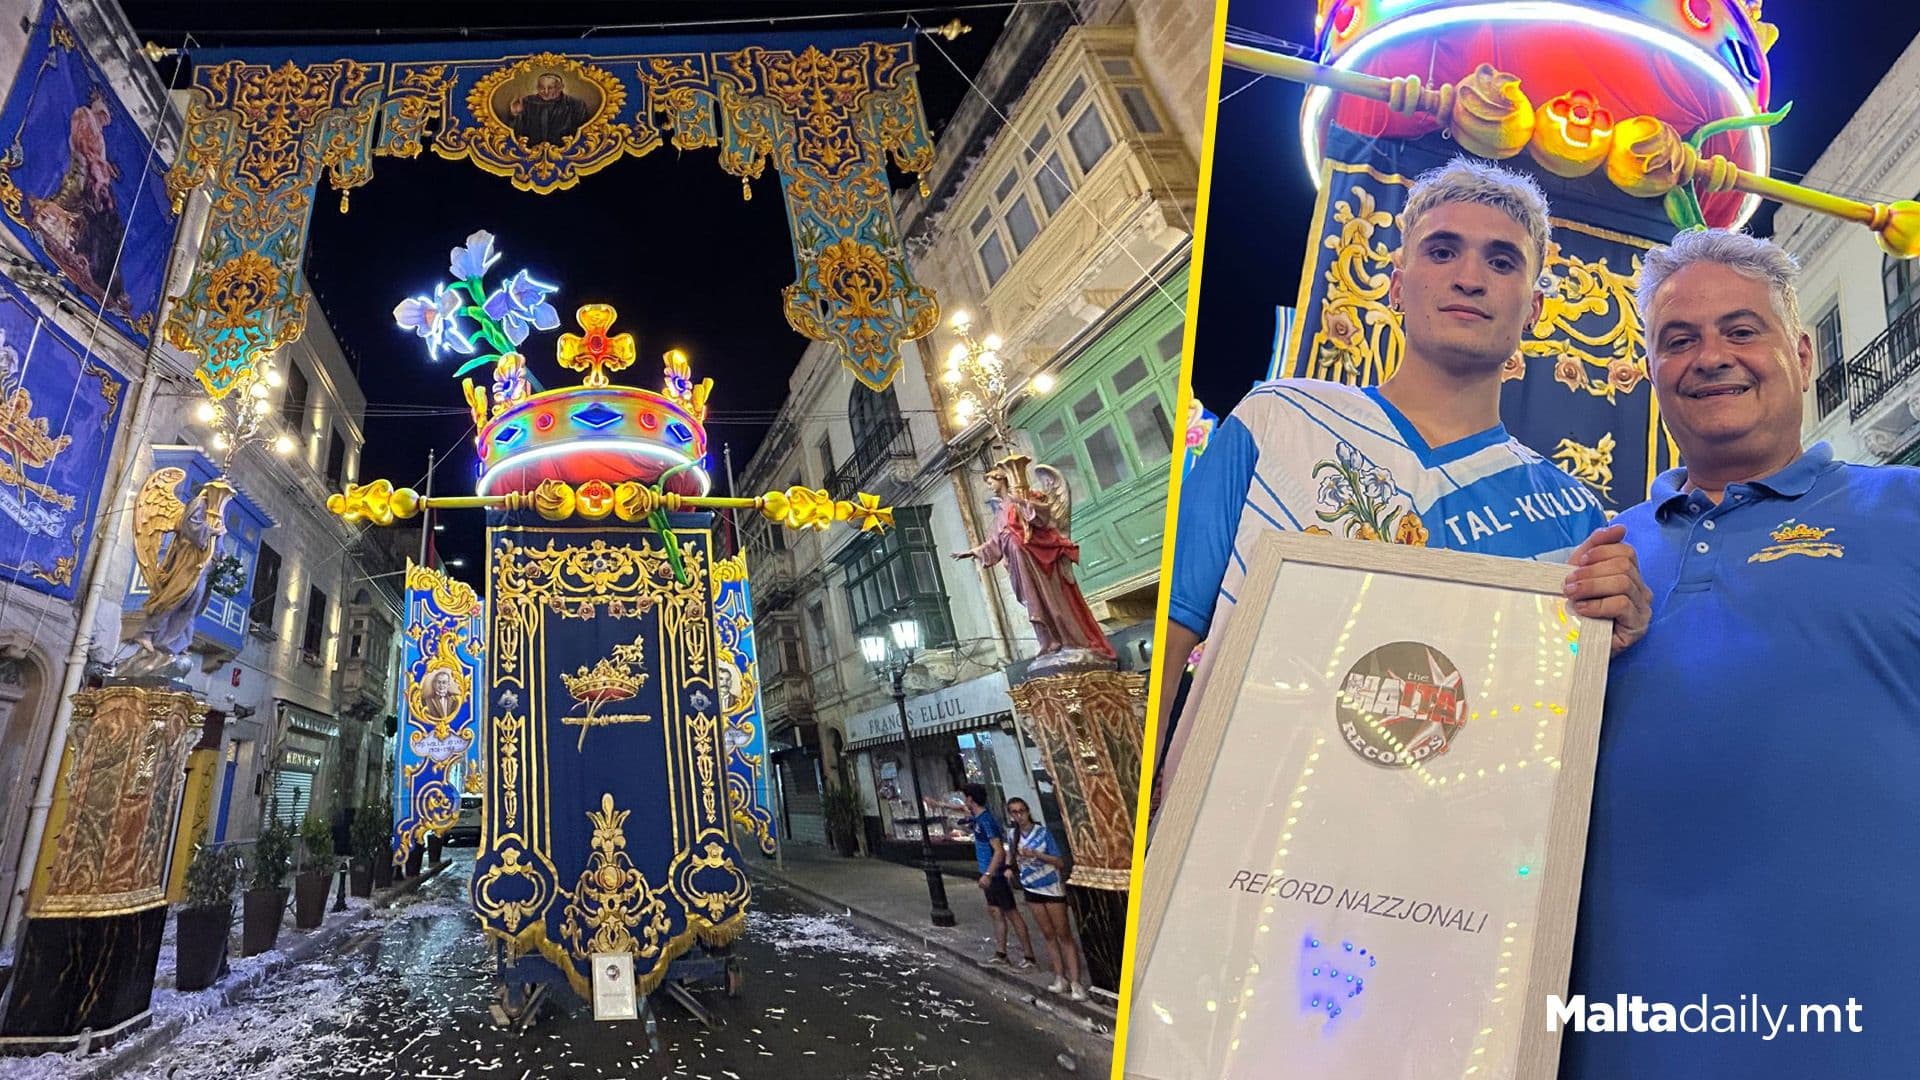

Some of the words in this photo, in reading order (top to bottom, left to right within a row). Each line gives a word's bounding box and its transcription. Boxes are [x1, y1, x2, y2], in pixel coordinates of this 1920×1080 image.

[1341, 672, 1458, 725] MALTA
[1407, 672, 1430, 681] the
[868, 710, 914, 735] FRANCS
[920, 698, 966, 723] ELLUL
[1229, 870, 1334, 905] REKORD
[1335, 888, 1489, 934] NAZZJONALI
